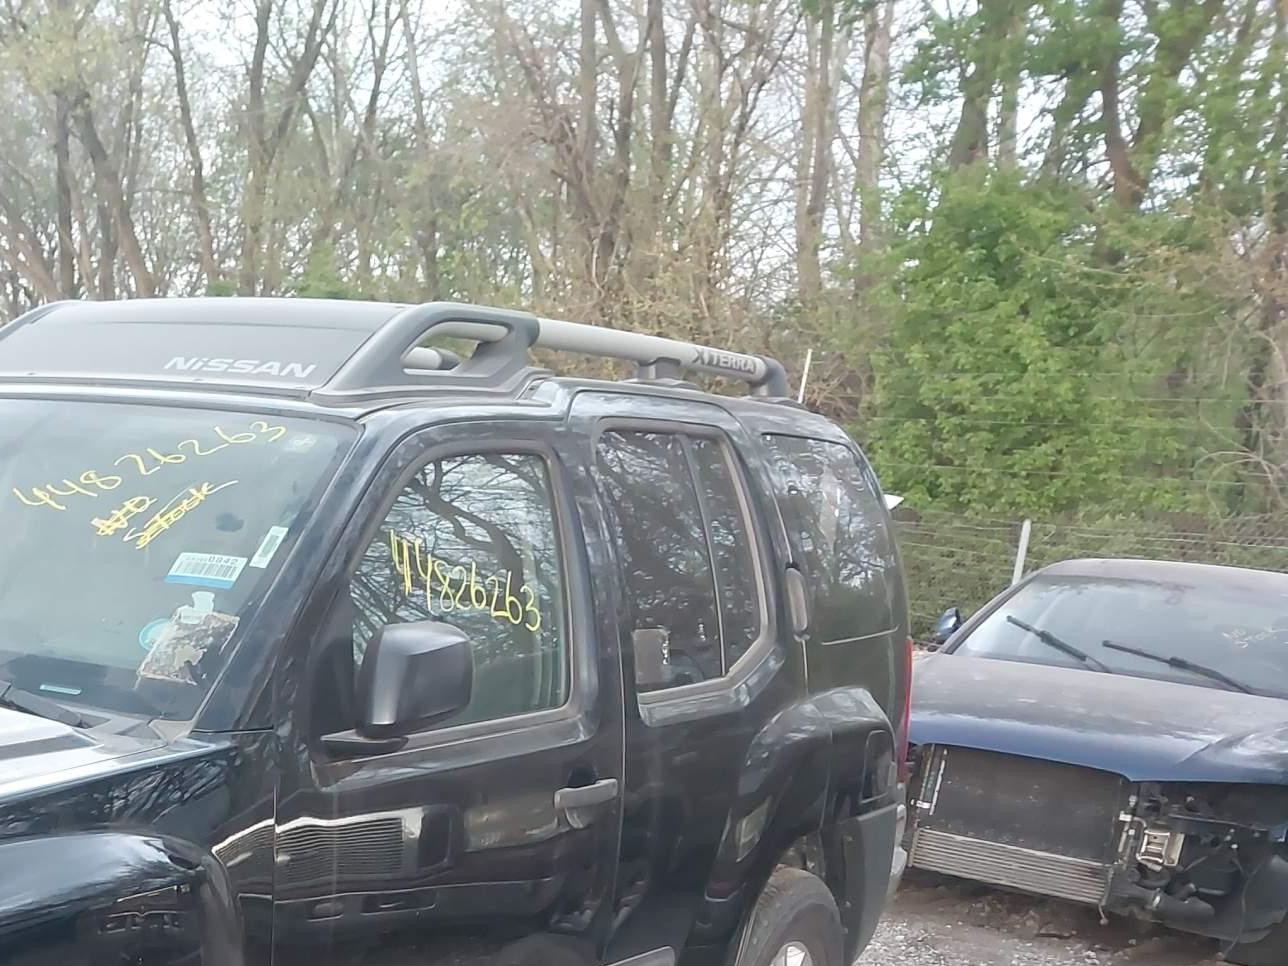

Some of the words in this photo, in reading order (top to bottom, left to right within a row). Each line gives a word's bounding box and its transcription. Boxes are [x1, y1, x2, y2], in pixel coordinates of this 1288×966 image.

[692, 346, 758, 375] XTERRA
[13, 420, 287, 511] 44826263
[390, 528, 541, 632] 44826263
